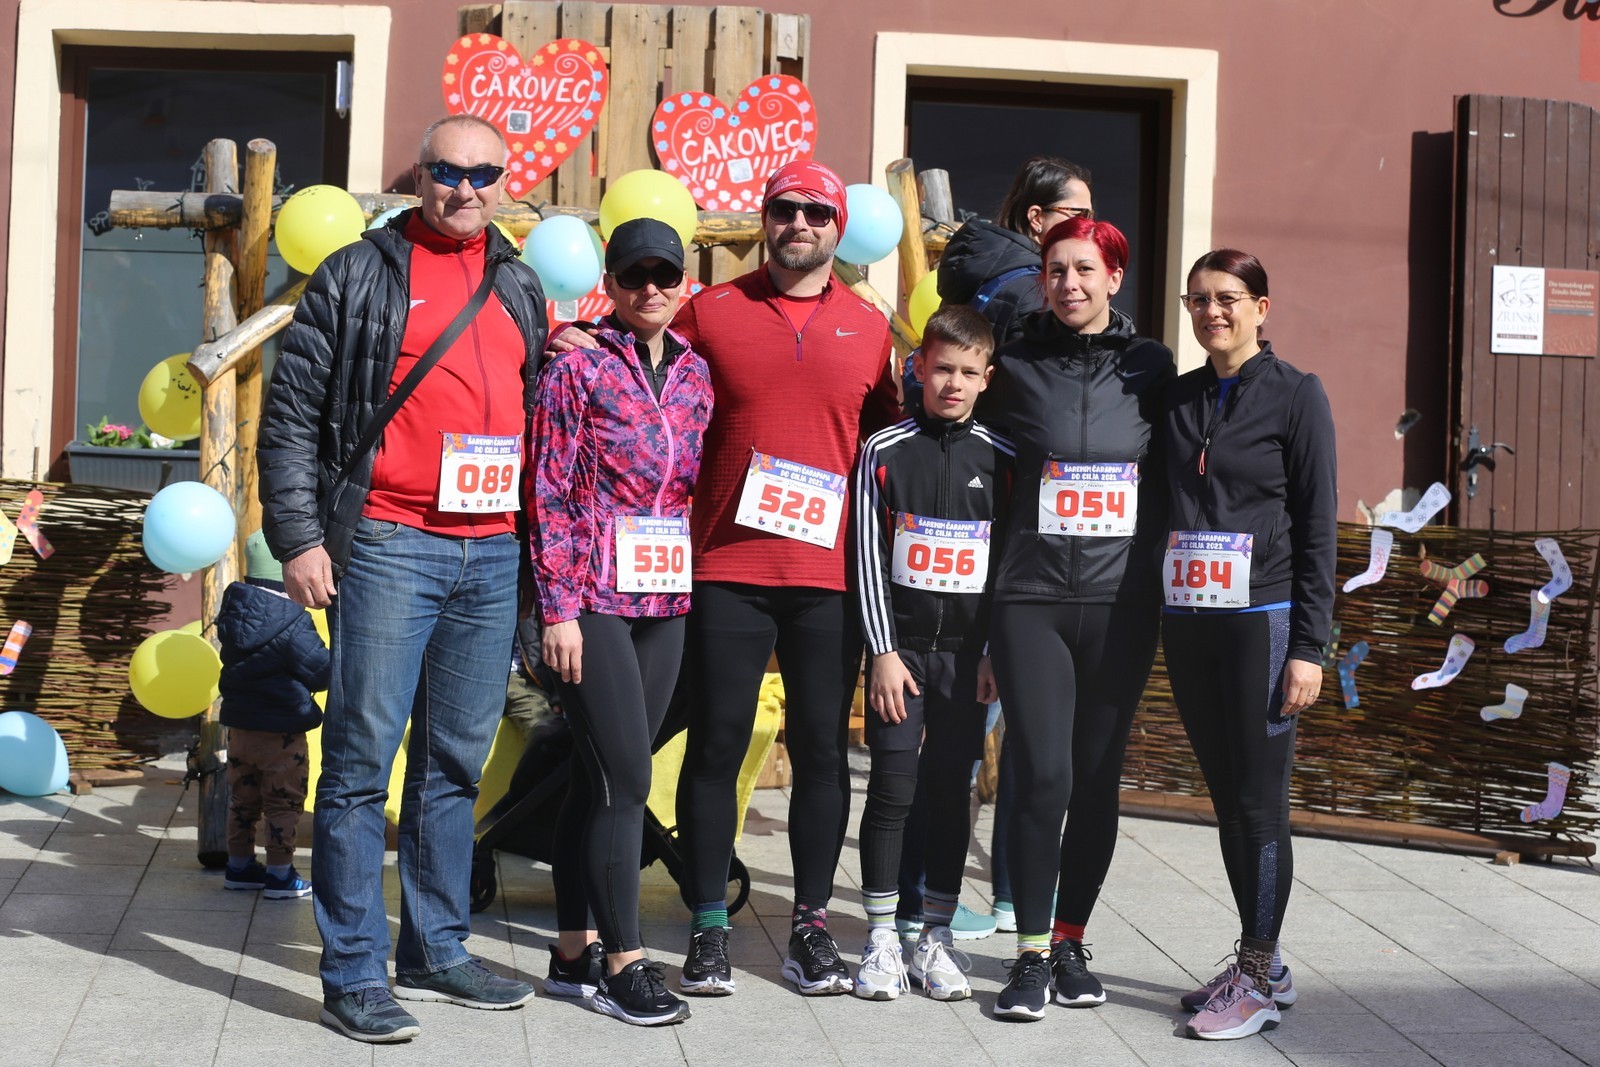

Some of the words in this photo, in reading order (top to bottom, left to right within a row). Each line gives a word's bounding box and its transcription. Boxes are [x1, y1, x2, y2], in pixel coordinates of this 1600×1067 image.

[470, 66, 590, 103] ČAKOVEC
[681, 119, 800, 166] ČAKOVEC
[457, 464, 513, 494] 089
[775, 458, 801, 473] ŠARENIM
[780, 470, 789, 478] DO
[790, 473, 807, 482] CILJA
[1064, 464, 1091, 473] ŠARENIM
[1092, 465, 1122, 473] ČARAPAMA
[758, 484, 826, 525] 528
[1056, 490, 1124, 518] 054
[918, 518, 945, 528] ŠARENIM
[946, 522, 975, 531] ČARAPAMA
[935, 529, 952, 537] CILJA
[1198, 533, 1231, 542] ČARAPAMA
[634, 545, 683, 574] 530
[907, 543, 975, 576] 056
[1172, 560, 1232, 589] 184
